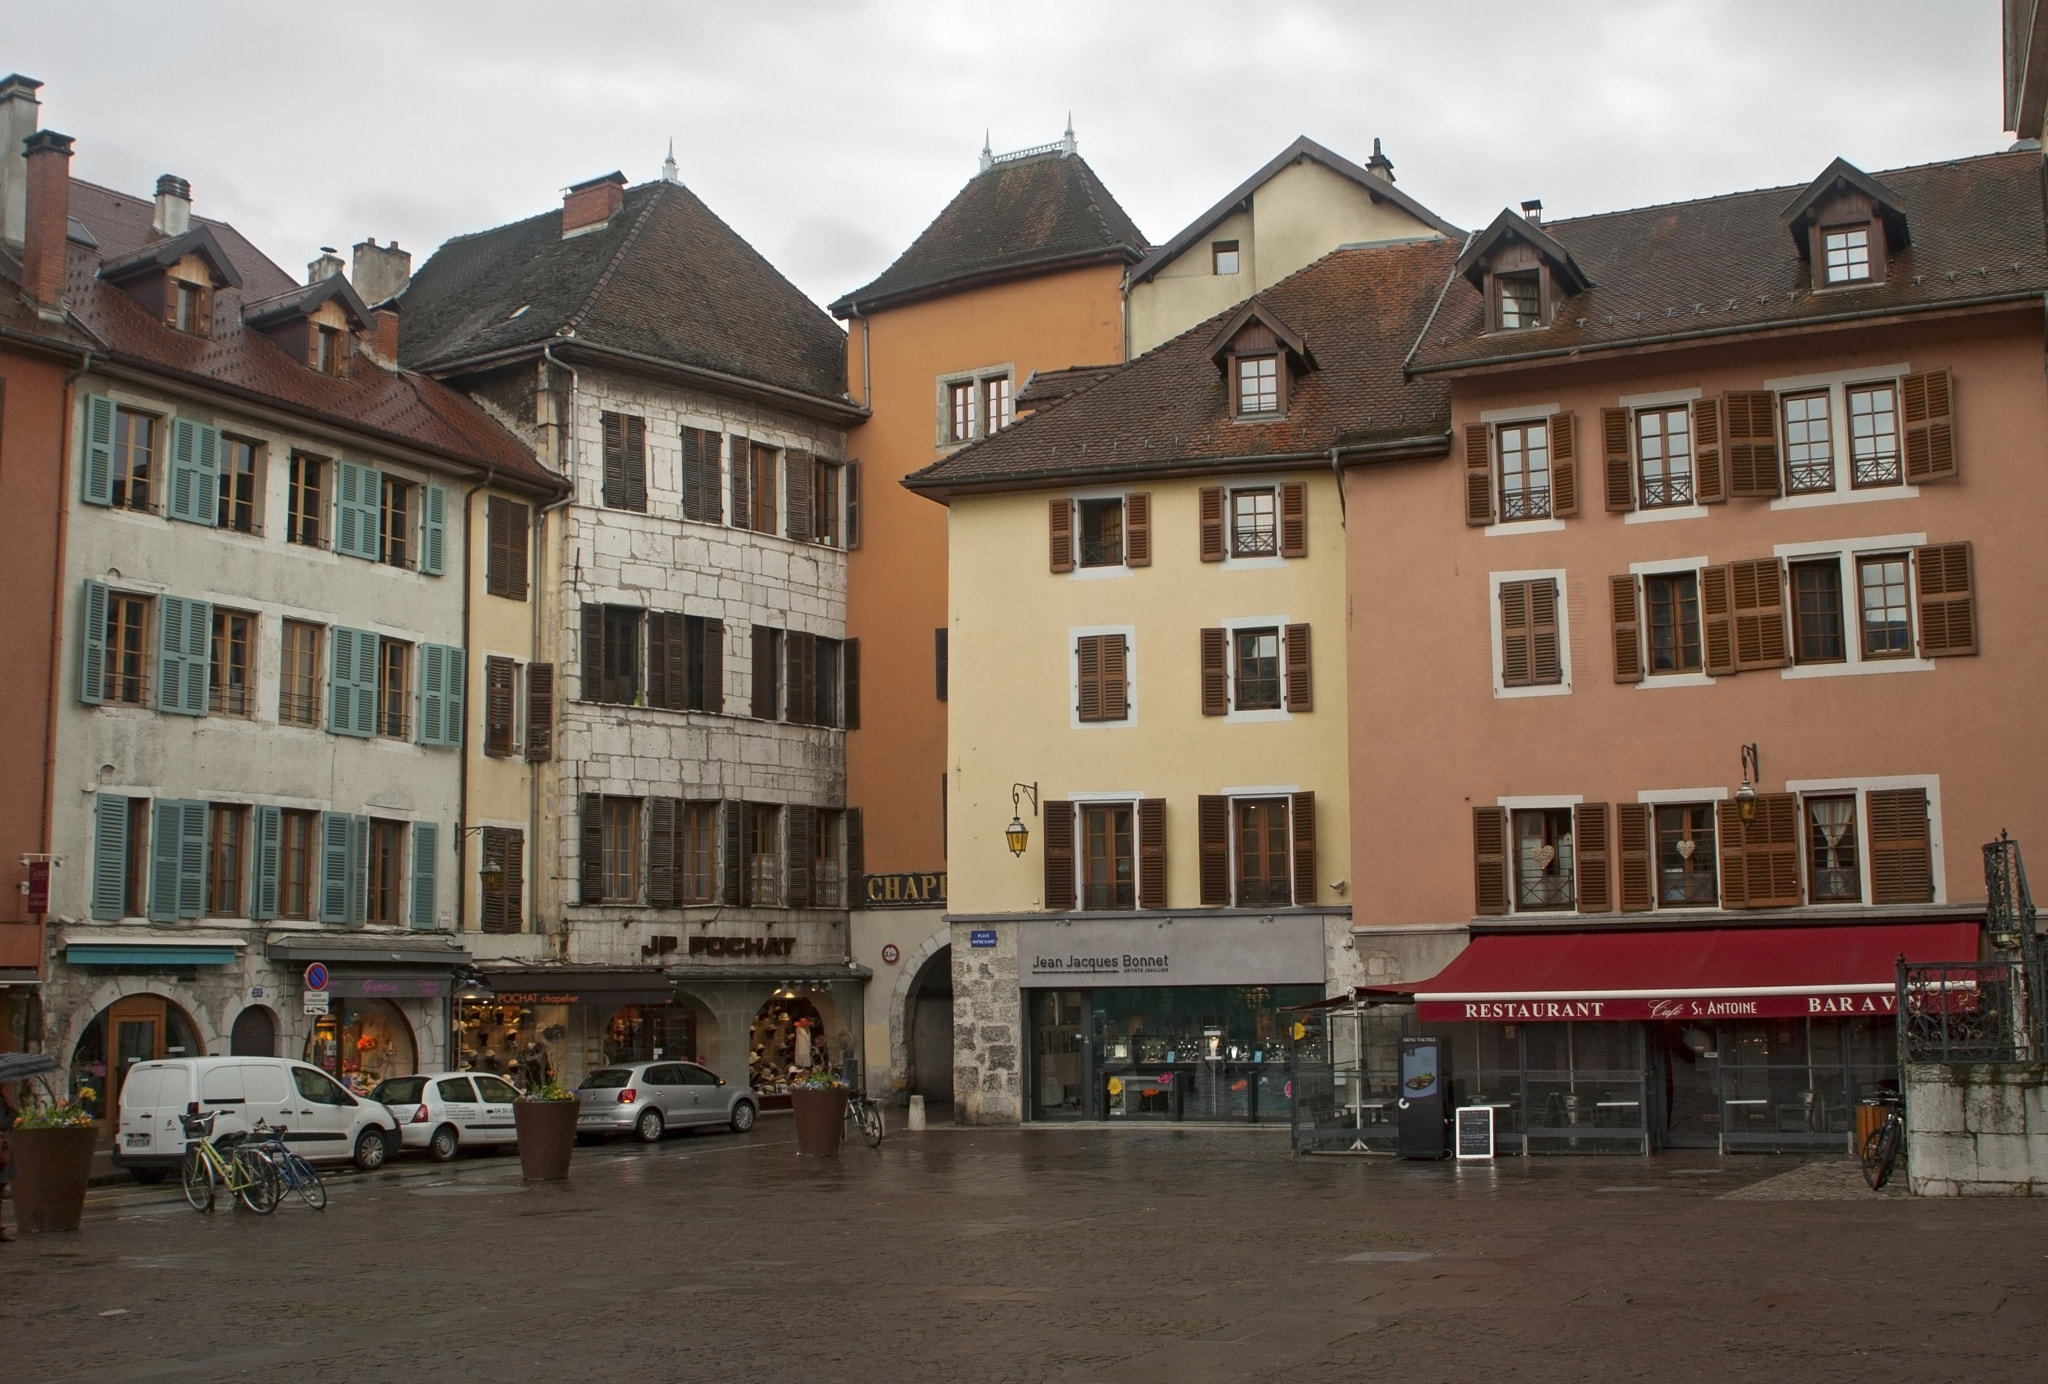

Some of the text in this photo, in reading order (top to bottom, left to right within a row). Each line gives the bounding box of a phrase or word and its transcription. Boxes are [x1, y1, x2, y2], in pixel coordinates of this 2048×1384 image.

[641, 935, 797, 957] JP POCHAT
[1033, 954, 1169, 971] Jean Jacques Bonnet
[497, 993, 579, 1005] POCHAT chapelier
[1807, 995, 1922, 1013] BAR A VN
[1464, 1002, 1605, 1018] RESTAURANT
[1647, 1000, 1684, 1019] Café
[1707, 1000, 1757, 1015] ANTOINE
